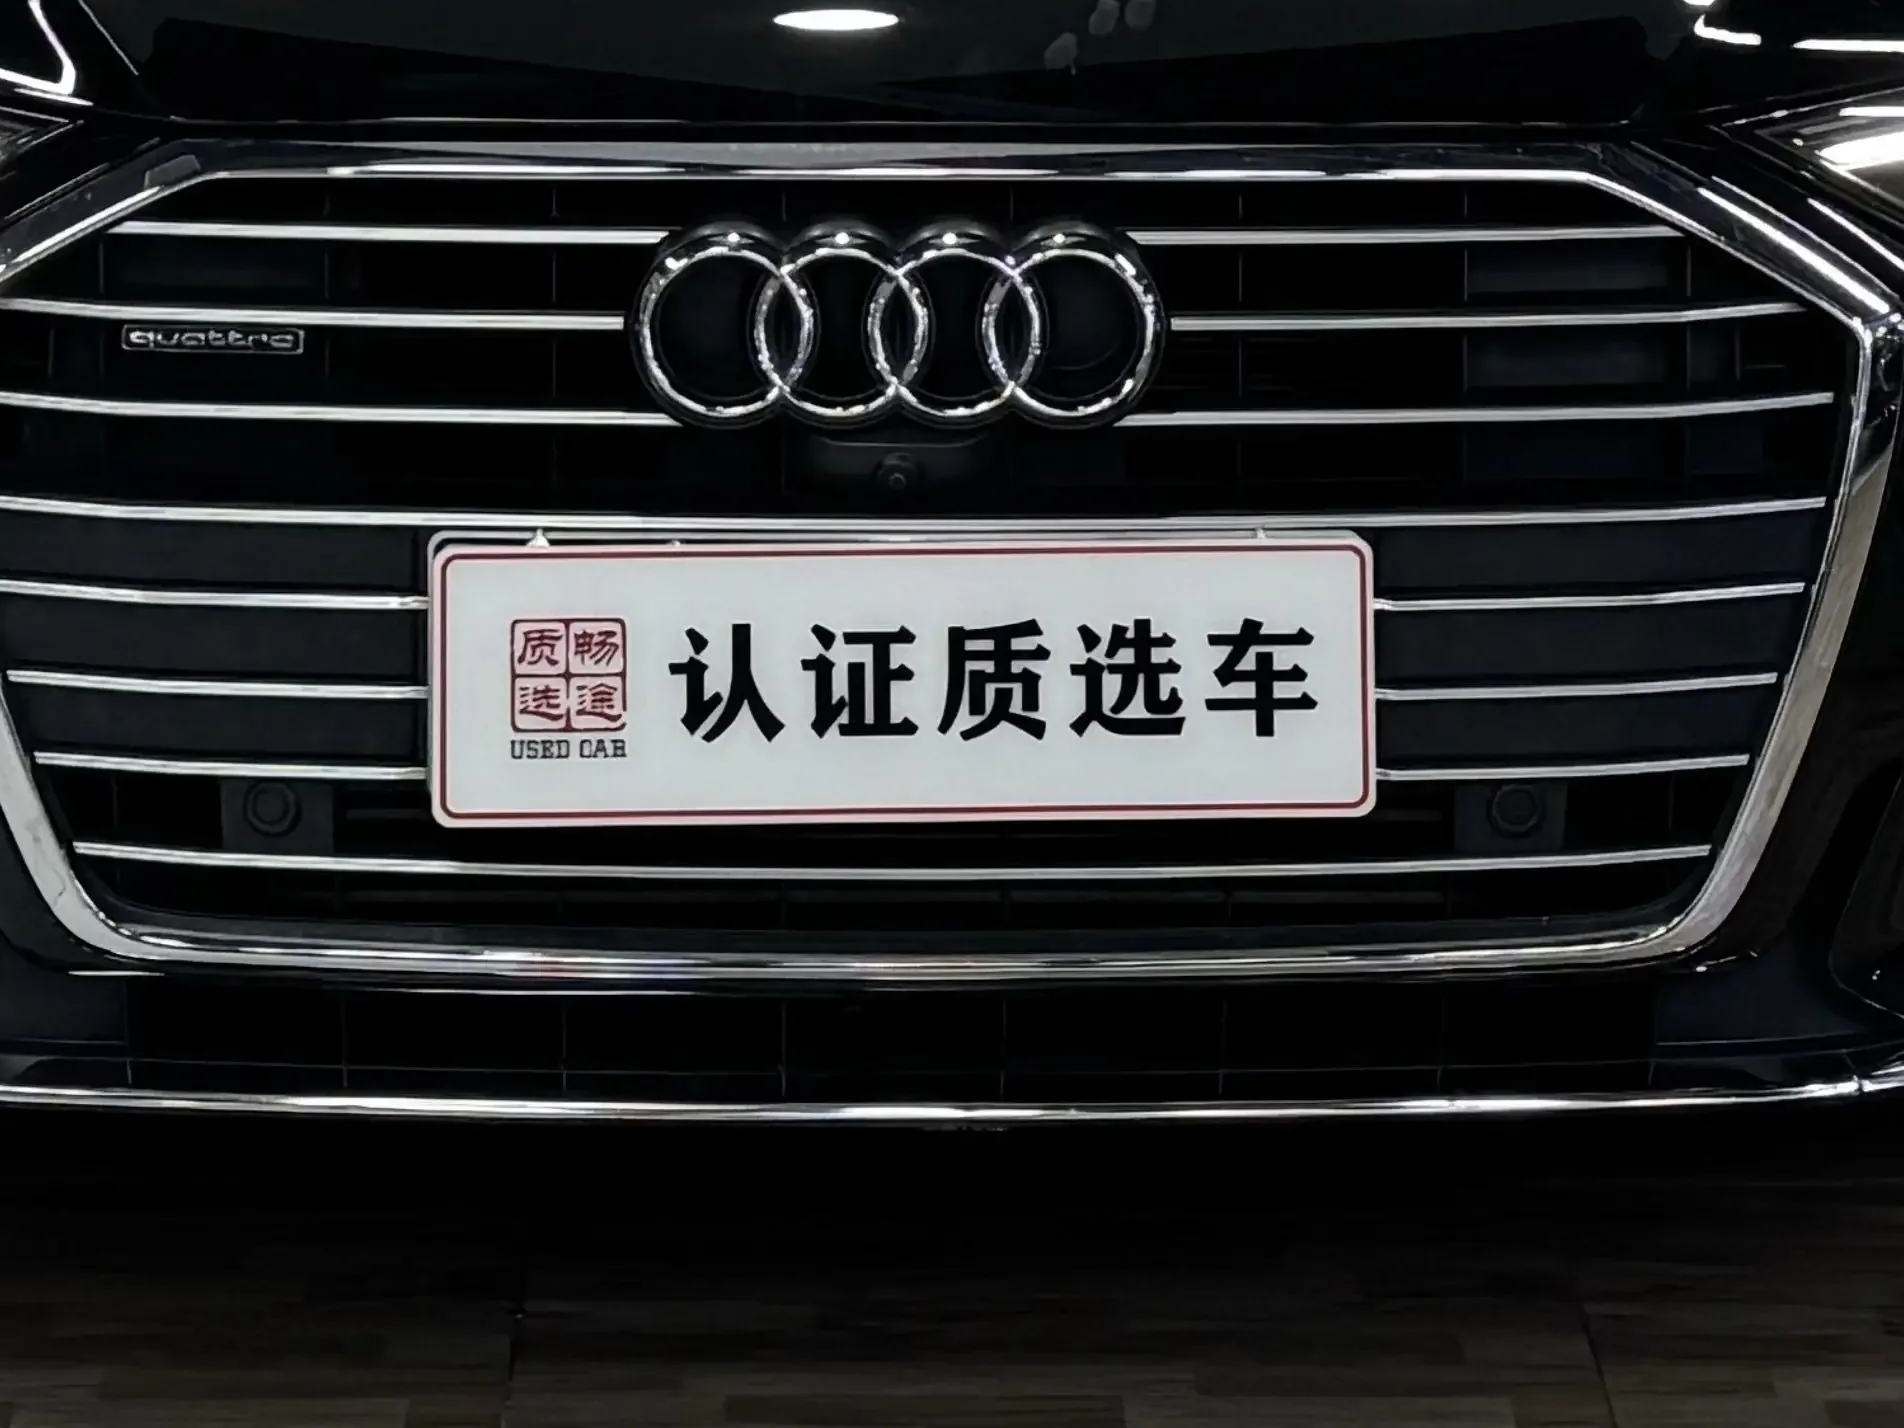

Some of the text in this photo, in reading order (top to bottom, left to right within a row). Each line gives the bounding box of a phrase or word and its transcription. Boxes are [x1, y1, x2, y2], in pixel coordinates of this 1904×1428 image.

[128, 329, 295, 350] quattro
[667, 617, 1319, 744] 认证质选车
[509, 737, 628, 760] USED CAR
